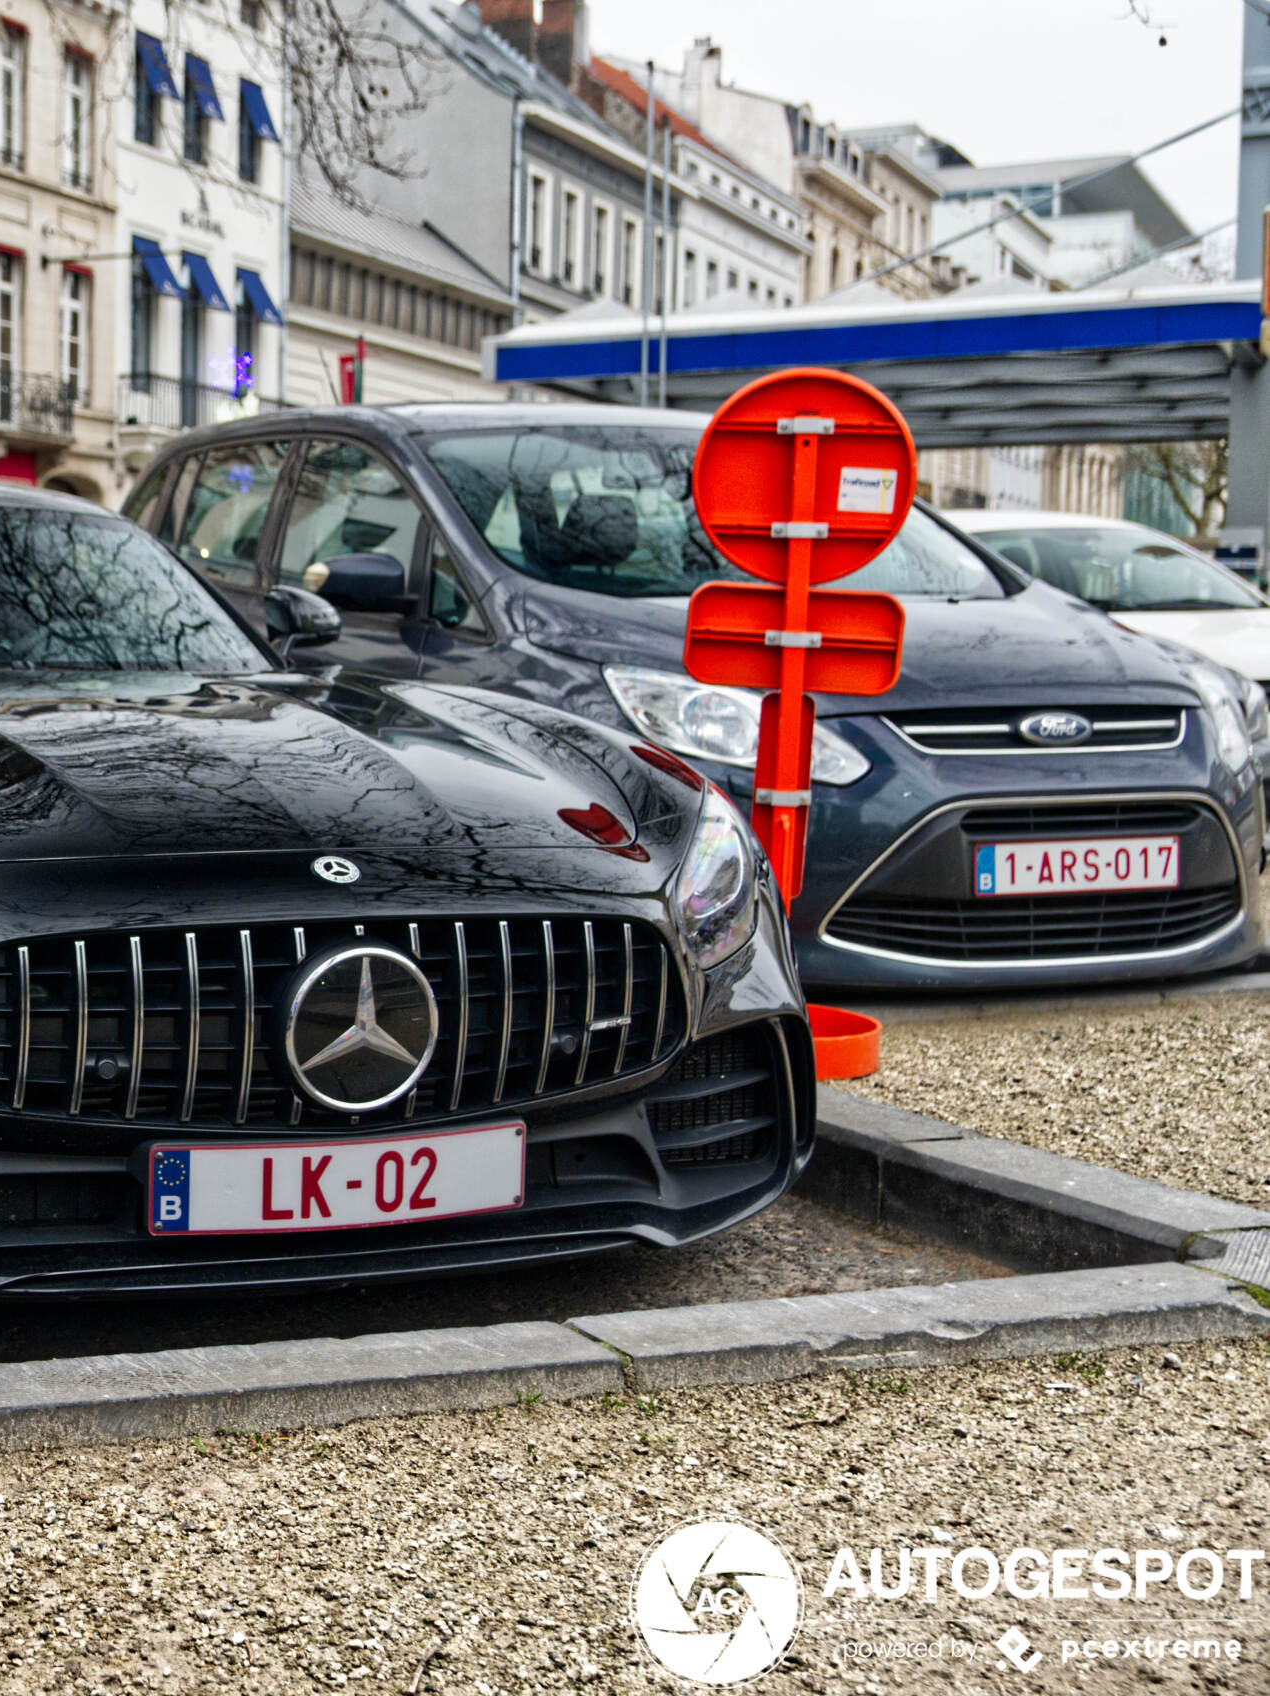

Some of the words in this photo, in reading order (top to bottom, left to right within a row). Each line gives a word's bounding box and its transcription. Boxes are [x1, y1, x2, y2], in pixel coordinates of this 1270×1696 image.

[1039, 716, 1077, 737] Ford
[980, 873, 992, 891] B
[1005, 846, 1173, 885] 1-ARS-017
[160, 1195, 182, 1221] B
[261, 1146, 438, 1221] LK-02
